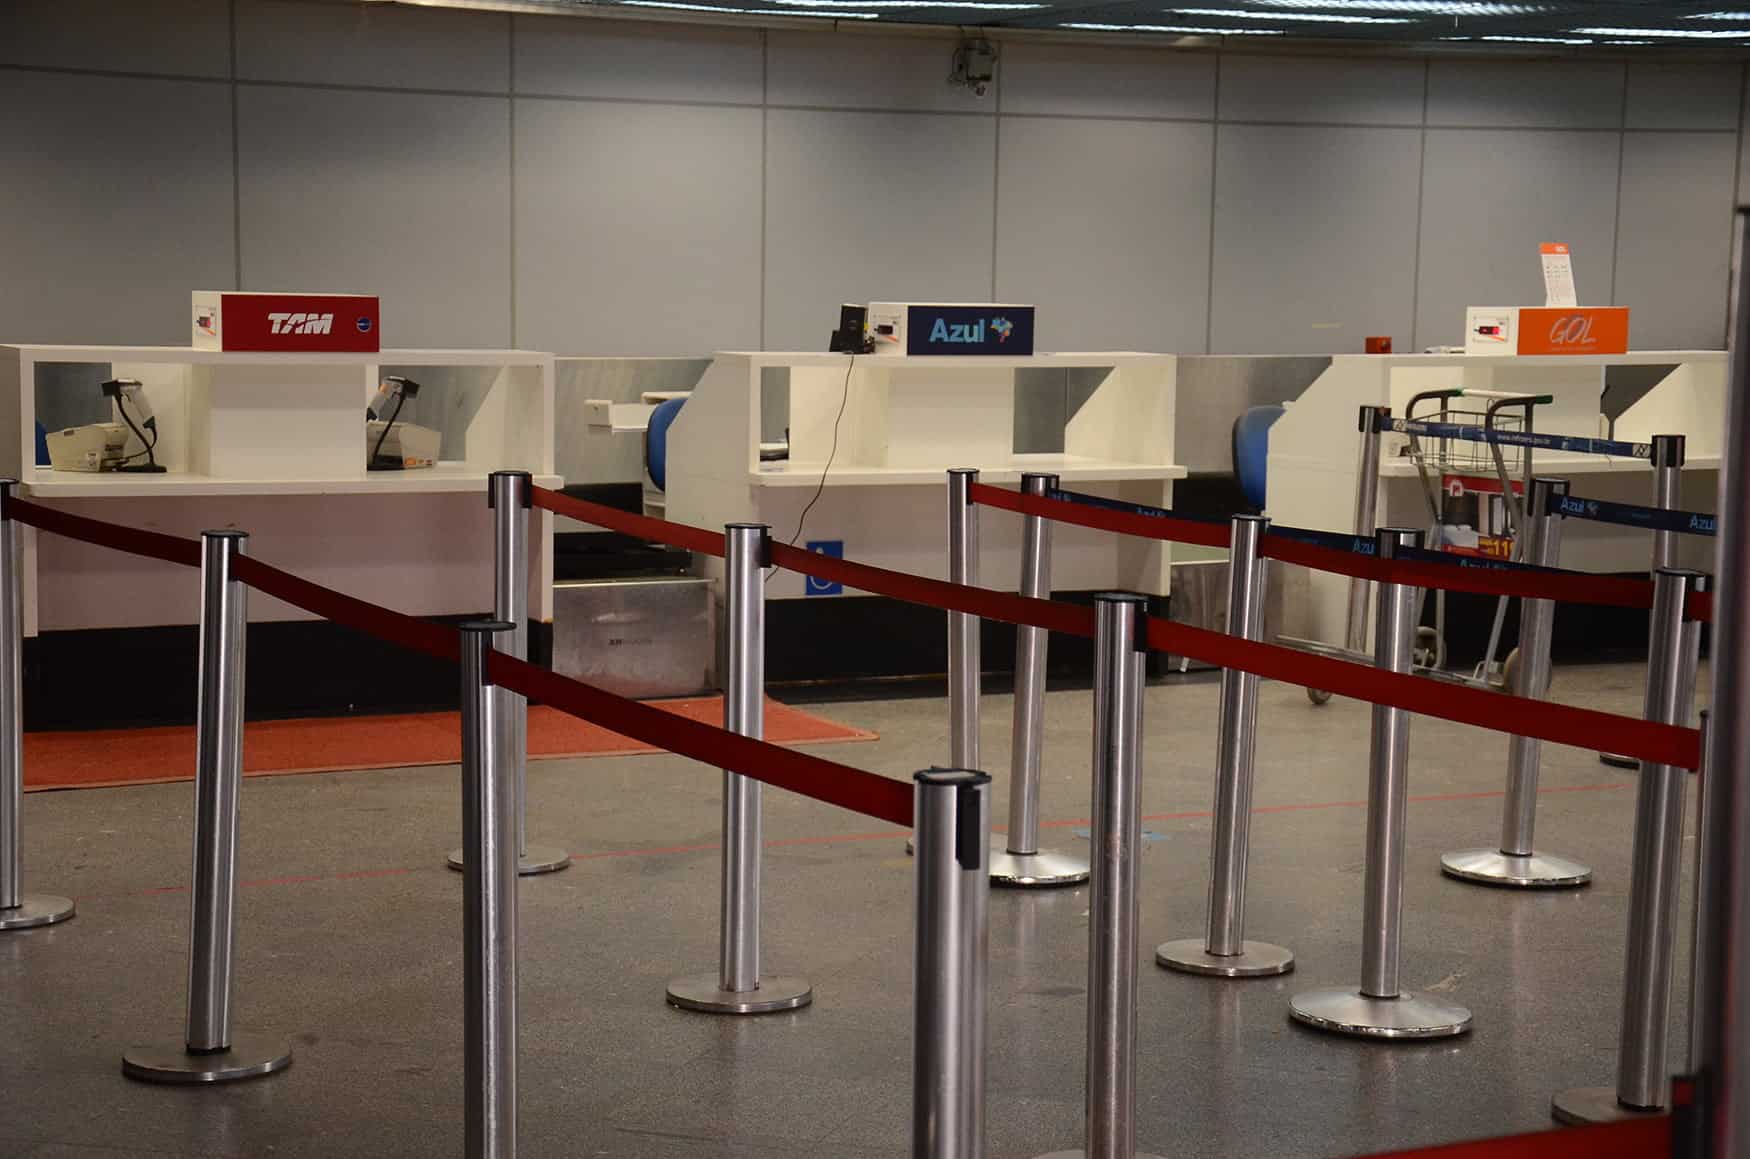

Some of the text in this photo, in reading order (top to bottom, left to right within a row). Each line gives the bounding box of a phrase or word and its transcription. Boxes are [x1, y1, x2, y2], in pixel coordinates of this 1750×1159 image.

[268, 313, 333, 334] TAM
[930, 318, 985, 342] Azul
[1550, 316, 1597, 344] GOL
[1560, 497, 1585, 513] Azul
[1352, 537, 1376, 554] Azu
